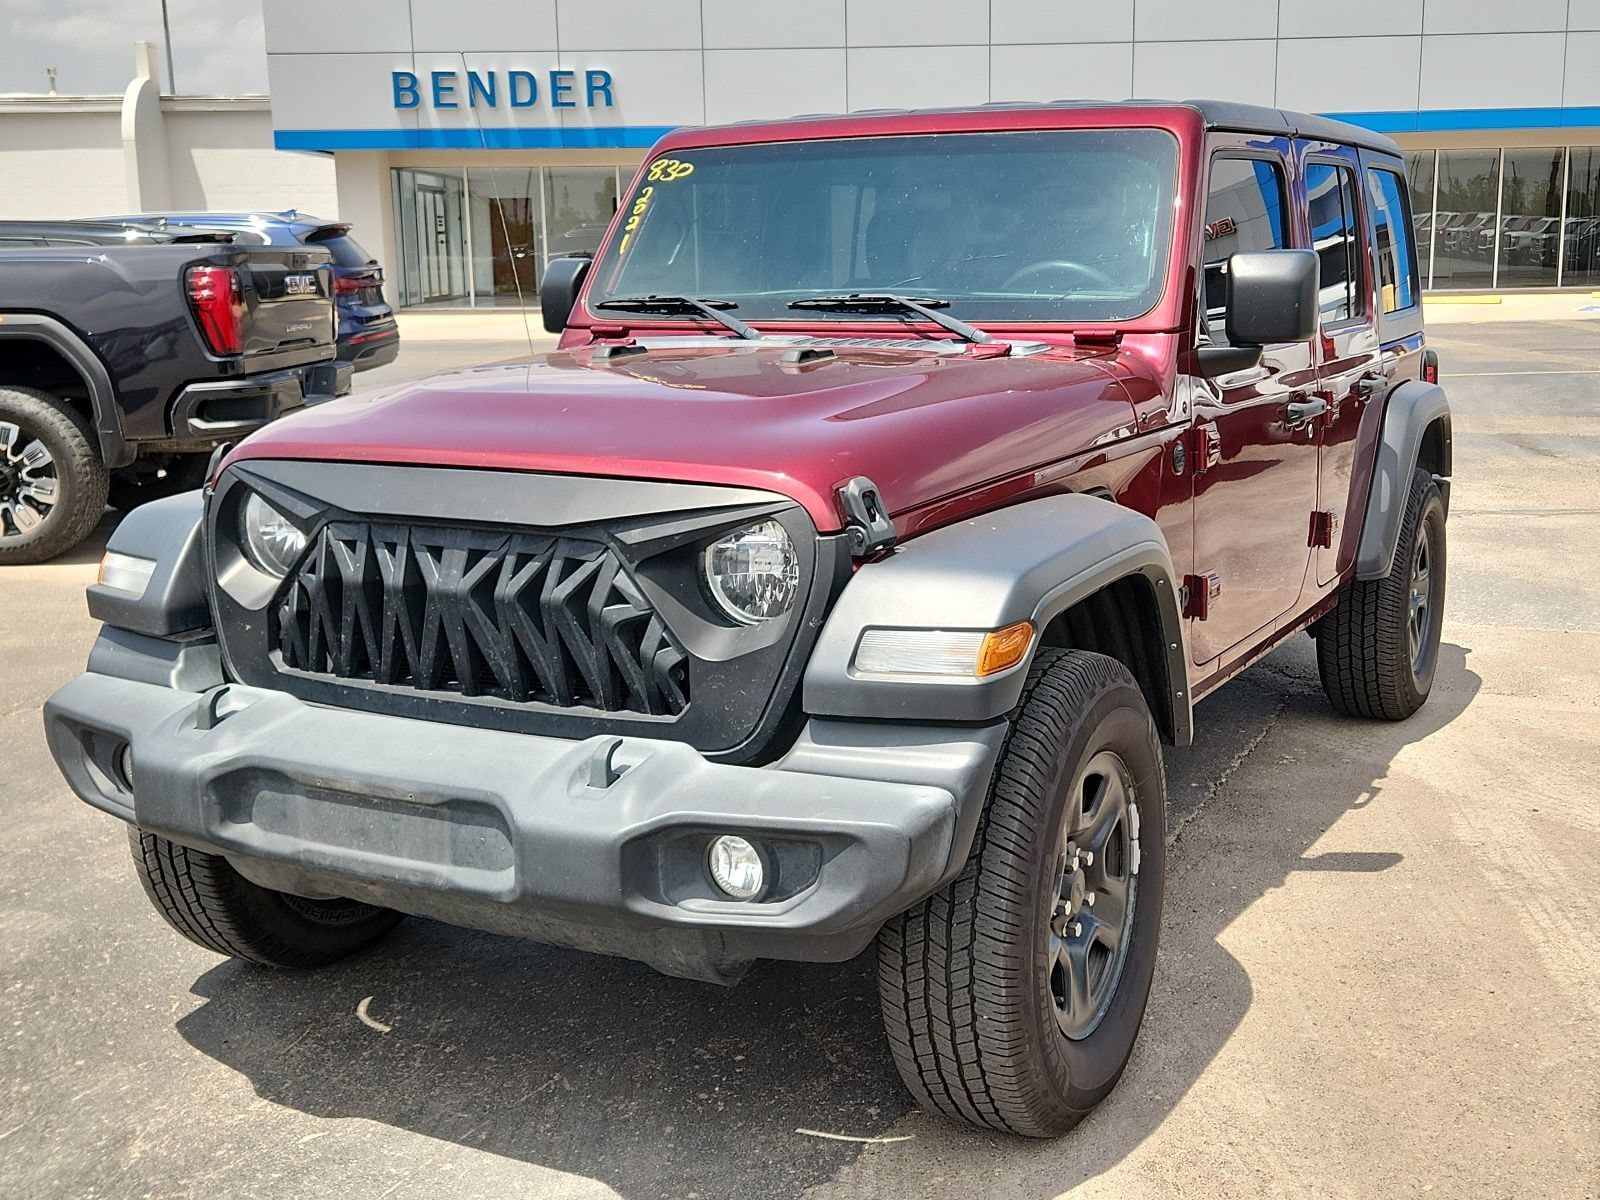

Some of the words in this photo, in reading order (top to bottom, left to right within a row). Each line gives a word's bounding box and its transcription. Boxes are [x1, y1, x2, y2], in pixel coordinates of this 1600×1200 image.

[392, 70, 614, 109] BENDER
[647, 158, 695, 182] 830
[619, 186, 655, 256] 2021
